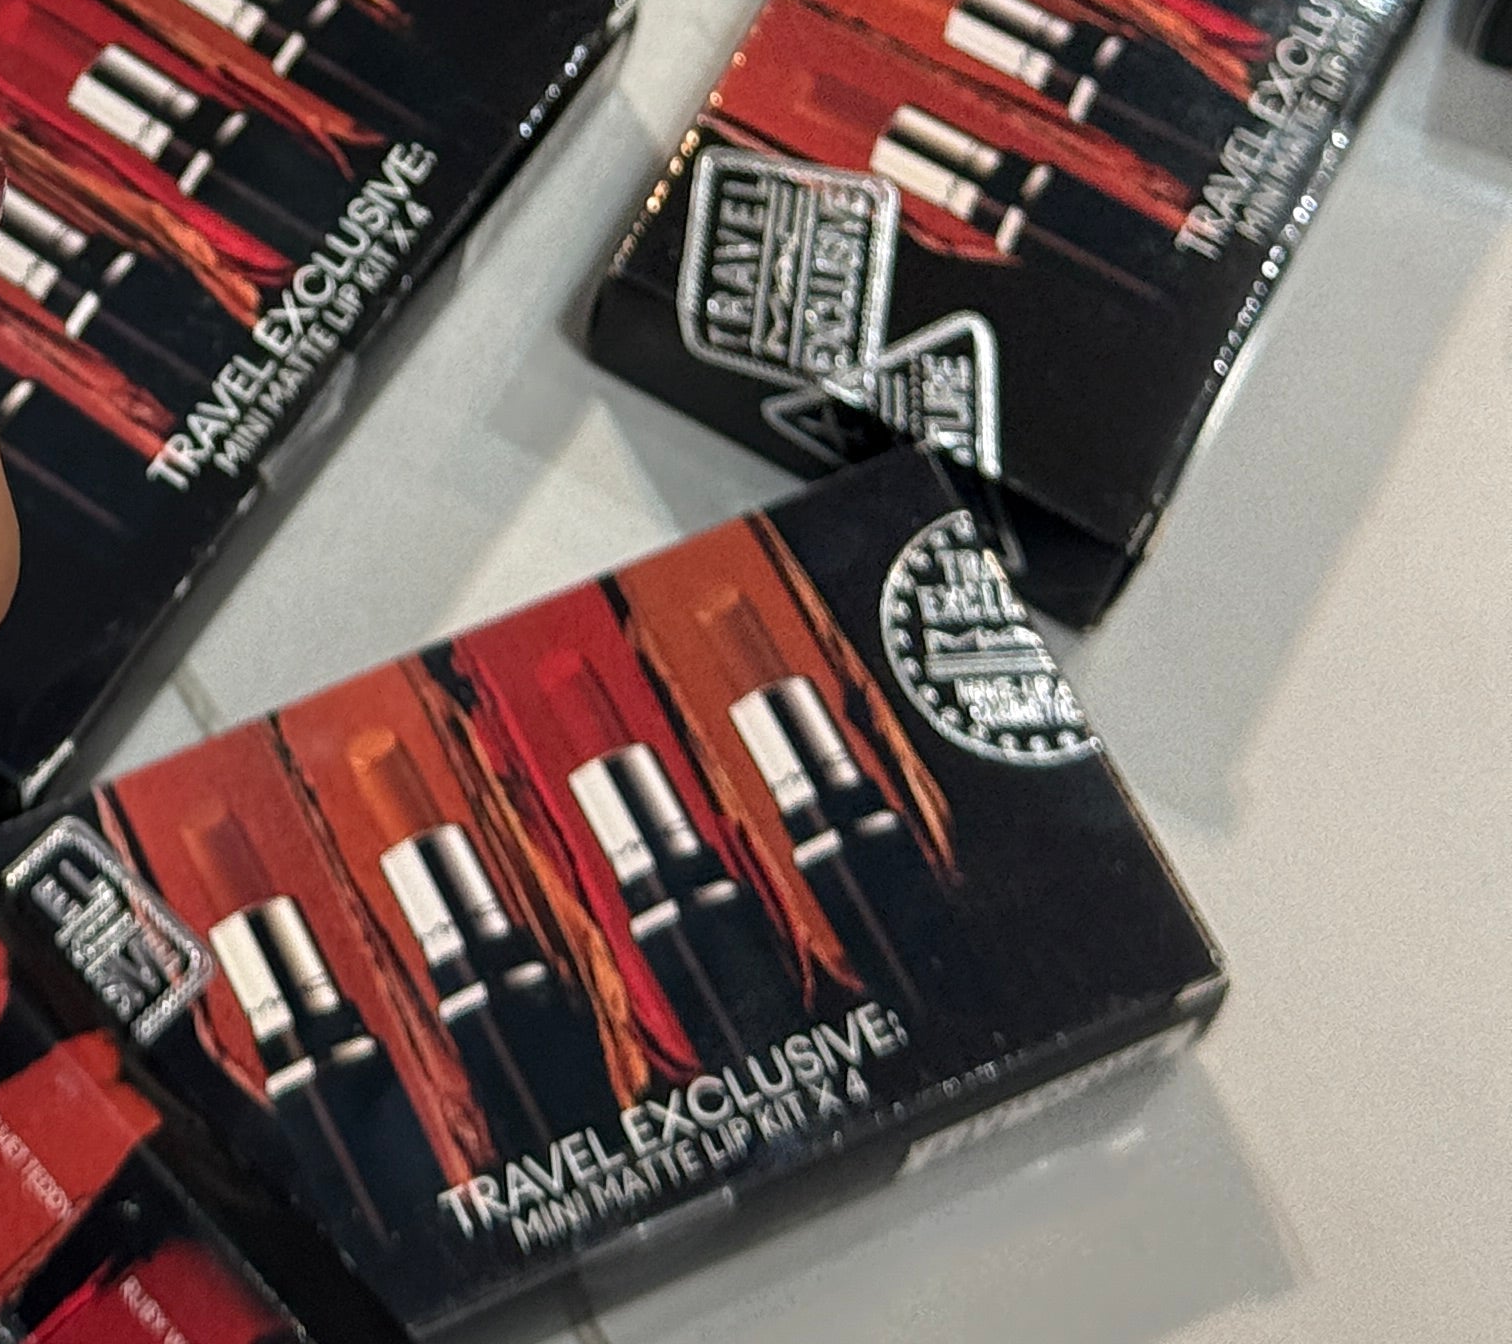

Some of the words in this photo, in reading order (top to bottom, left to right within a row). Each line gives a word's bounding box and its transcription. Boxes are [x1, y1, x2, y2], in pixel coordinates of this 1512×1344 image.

[701, 170, 771, 350] TRAVEL
[1169, 113, 1285, 270] TRAVEL
[138, 337, 283, 503] TRAVEL
[206, 402, 279, 481] MINI
[252, 317, 343, 421] MATTE
[317, 277, 375, 337] LIP
[348, 239, 403, 296] KIT
[397, 195, 437, 233] 4
[434, 1111, 631, 1246] TRAVEL
[507, 1186, 594, 1258] MINI
[584, 1133, 709, 1224] MATTE
[697, 1112, 762, 1173] LIP
[749, 1088, 816, 1150] KIT
[837, 1063, 875, 1111] 4
